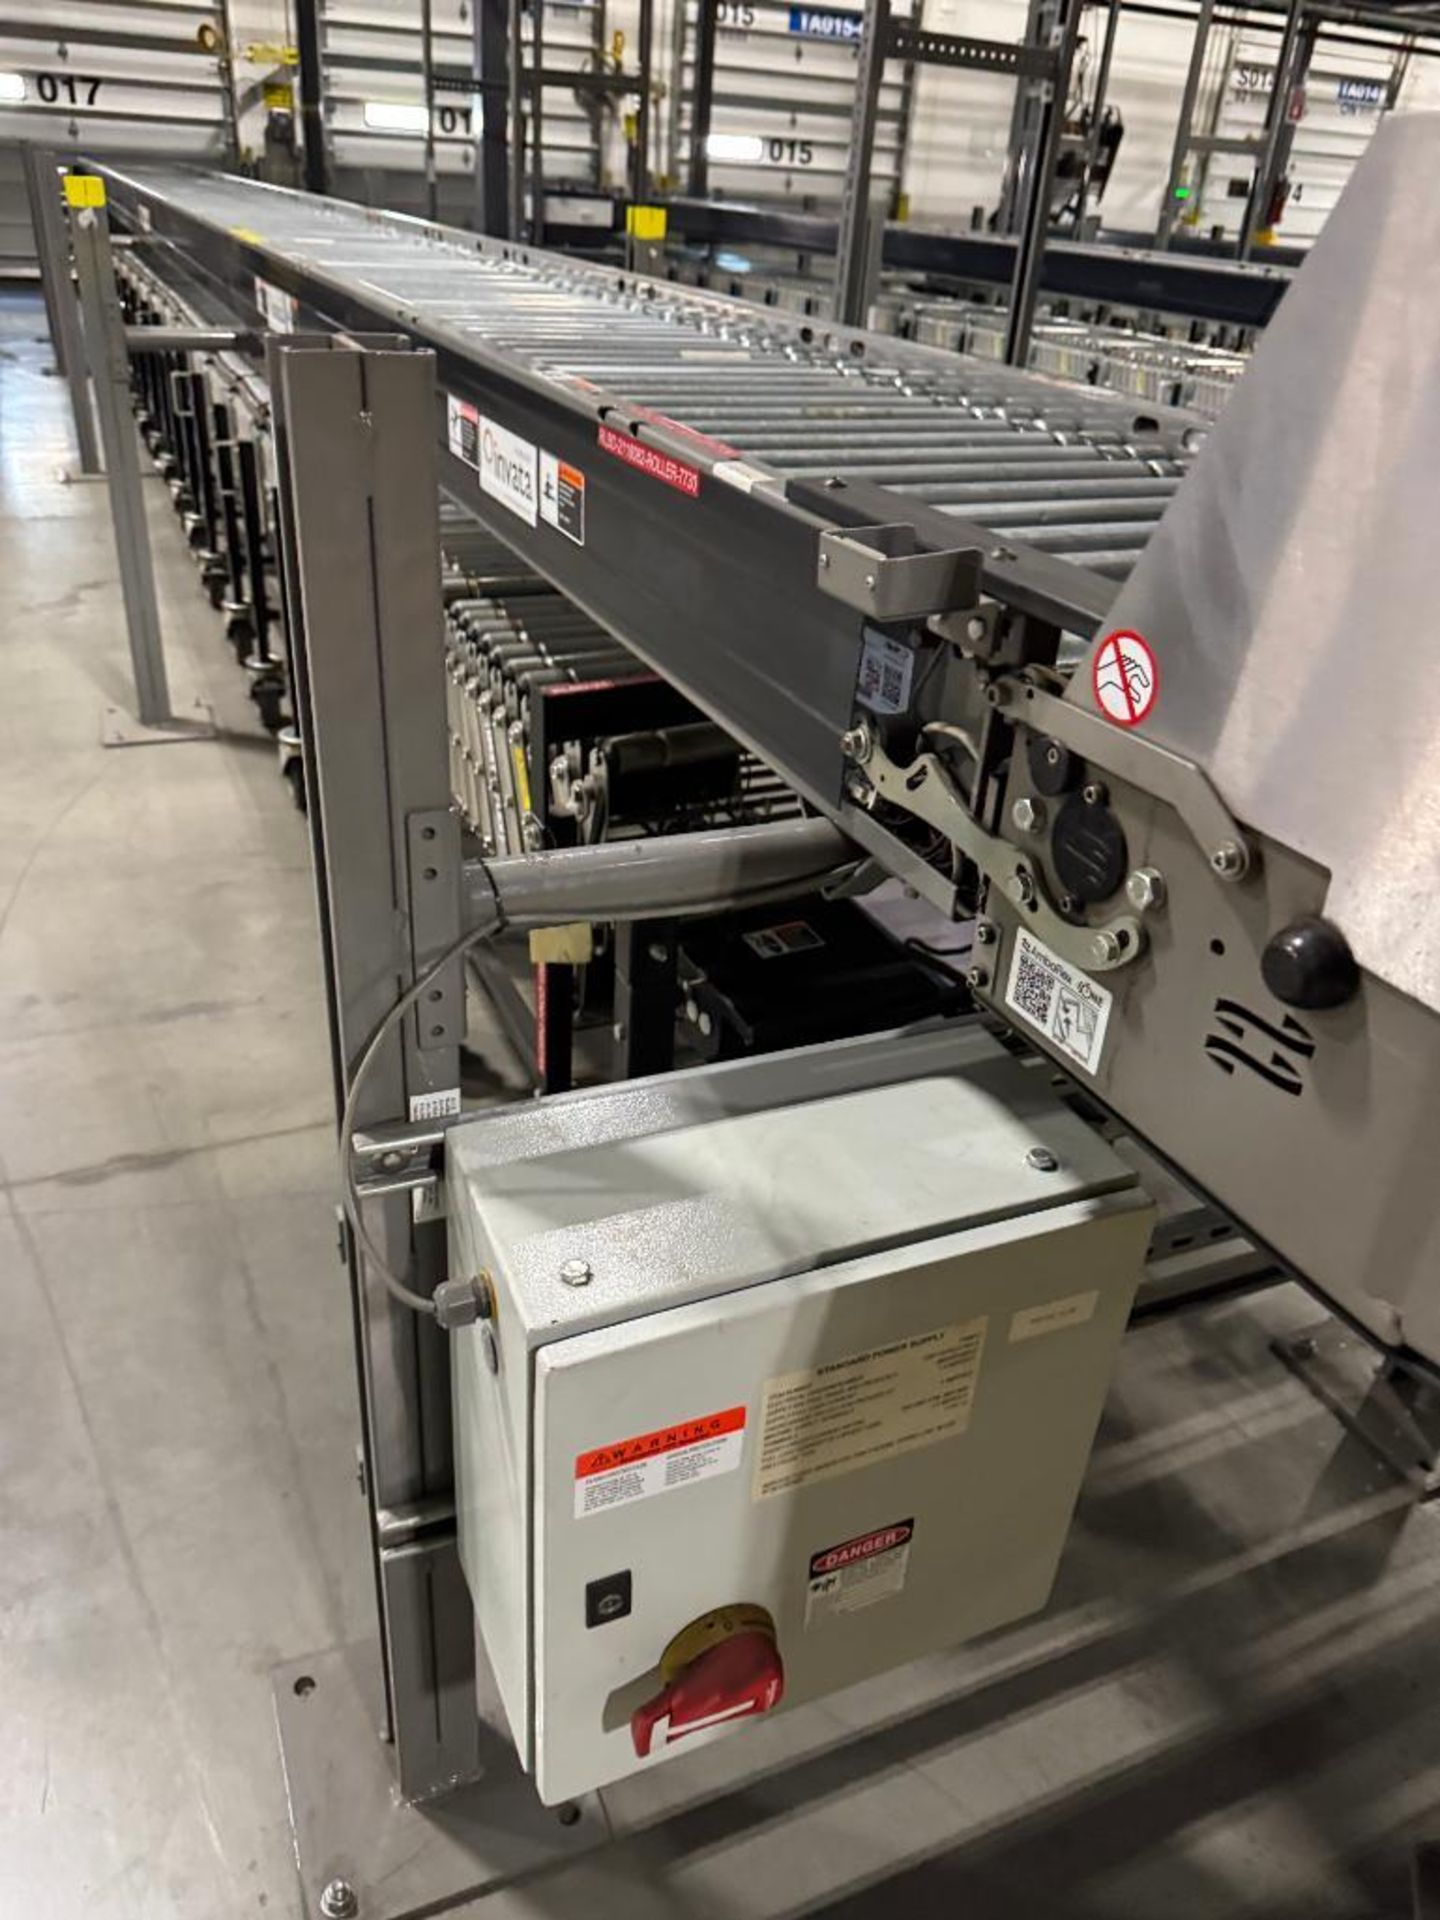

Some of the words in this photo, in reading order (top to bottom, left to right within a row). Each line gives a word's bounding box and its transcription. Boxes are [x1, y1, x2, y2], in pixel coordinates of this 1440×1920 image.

[37, 73, 100, 105] 017
[769, 138, 812, 164] 015
[612, 1419, 721, 1460] WARNING
[826, 1532, 896, 1566] DANGER
